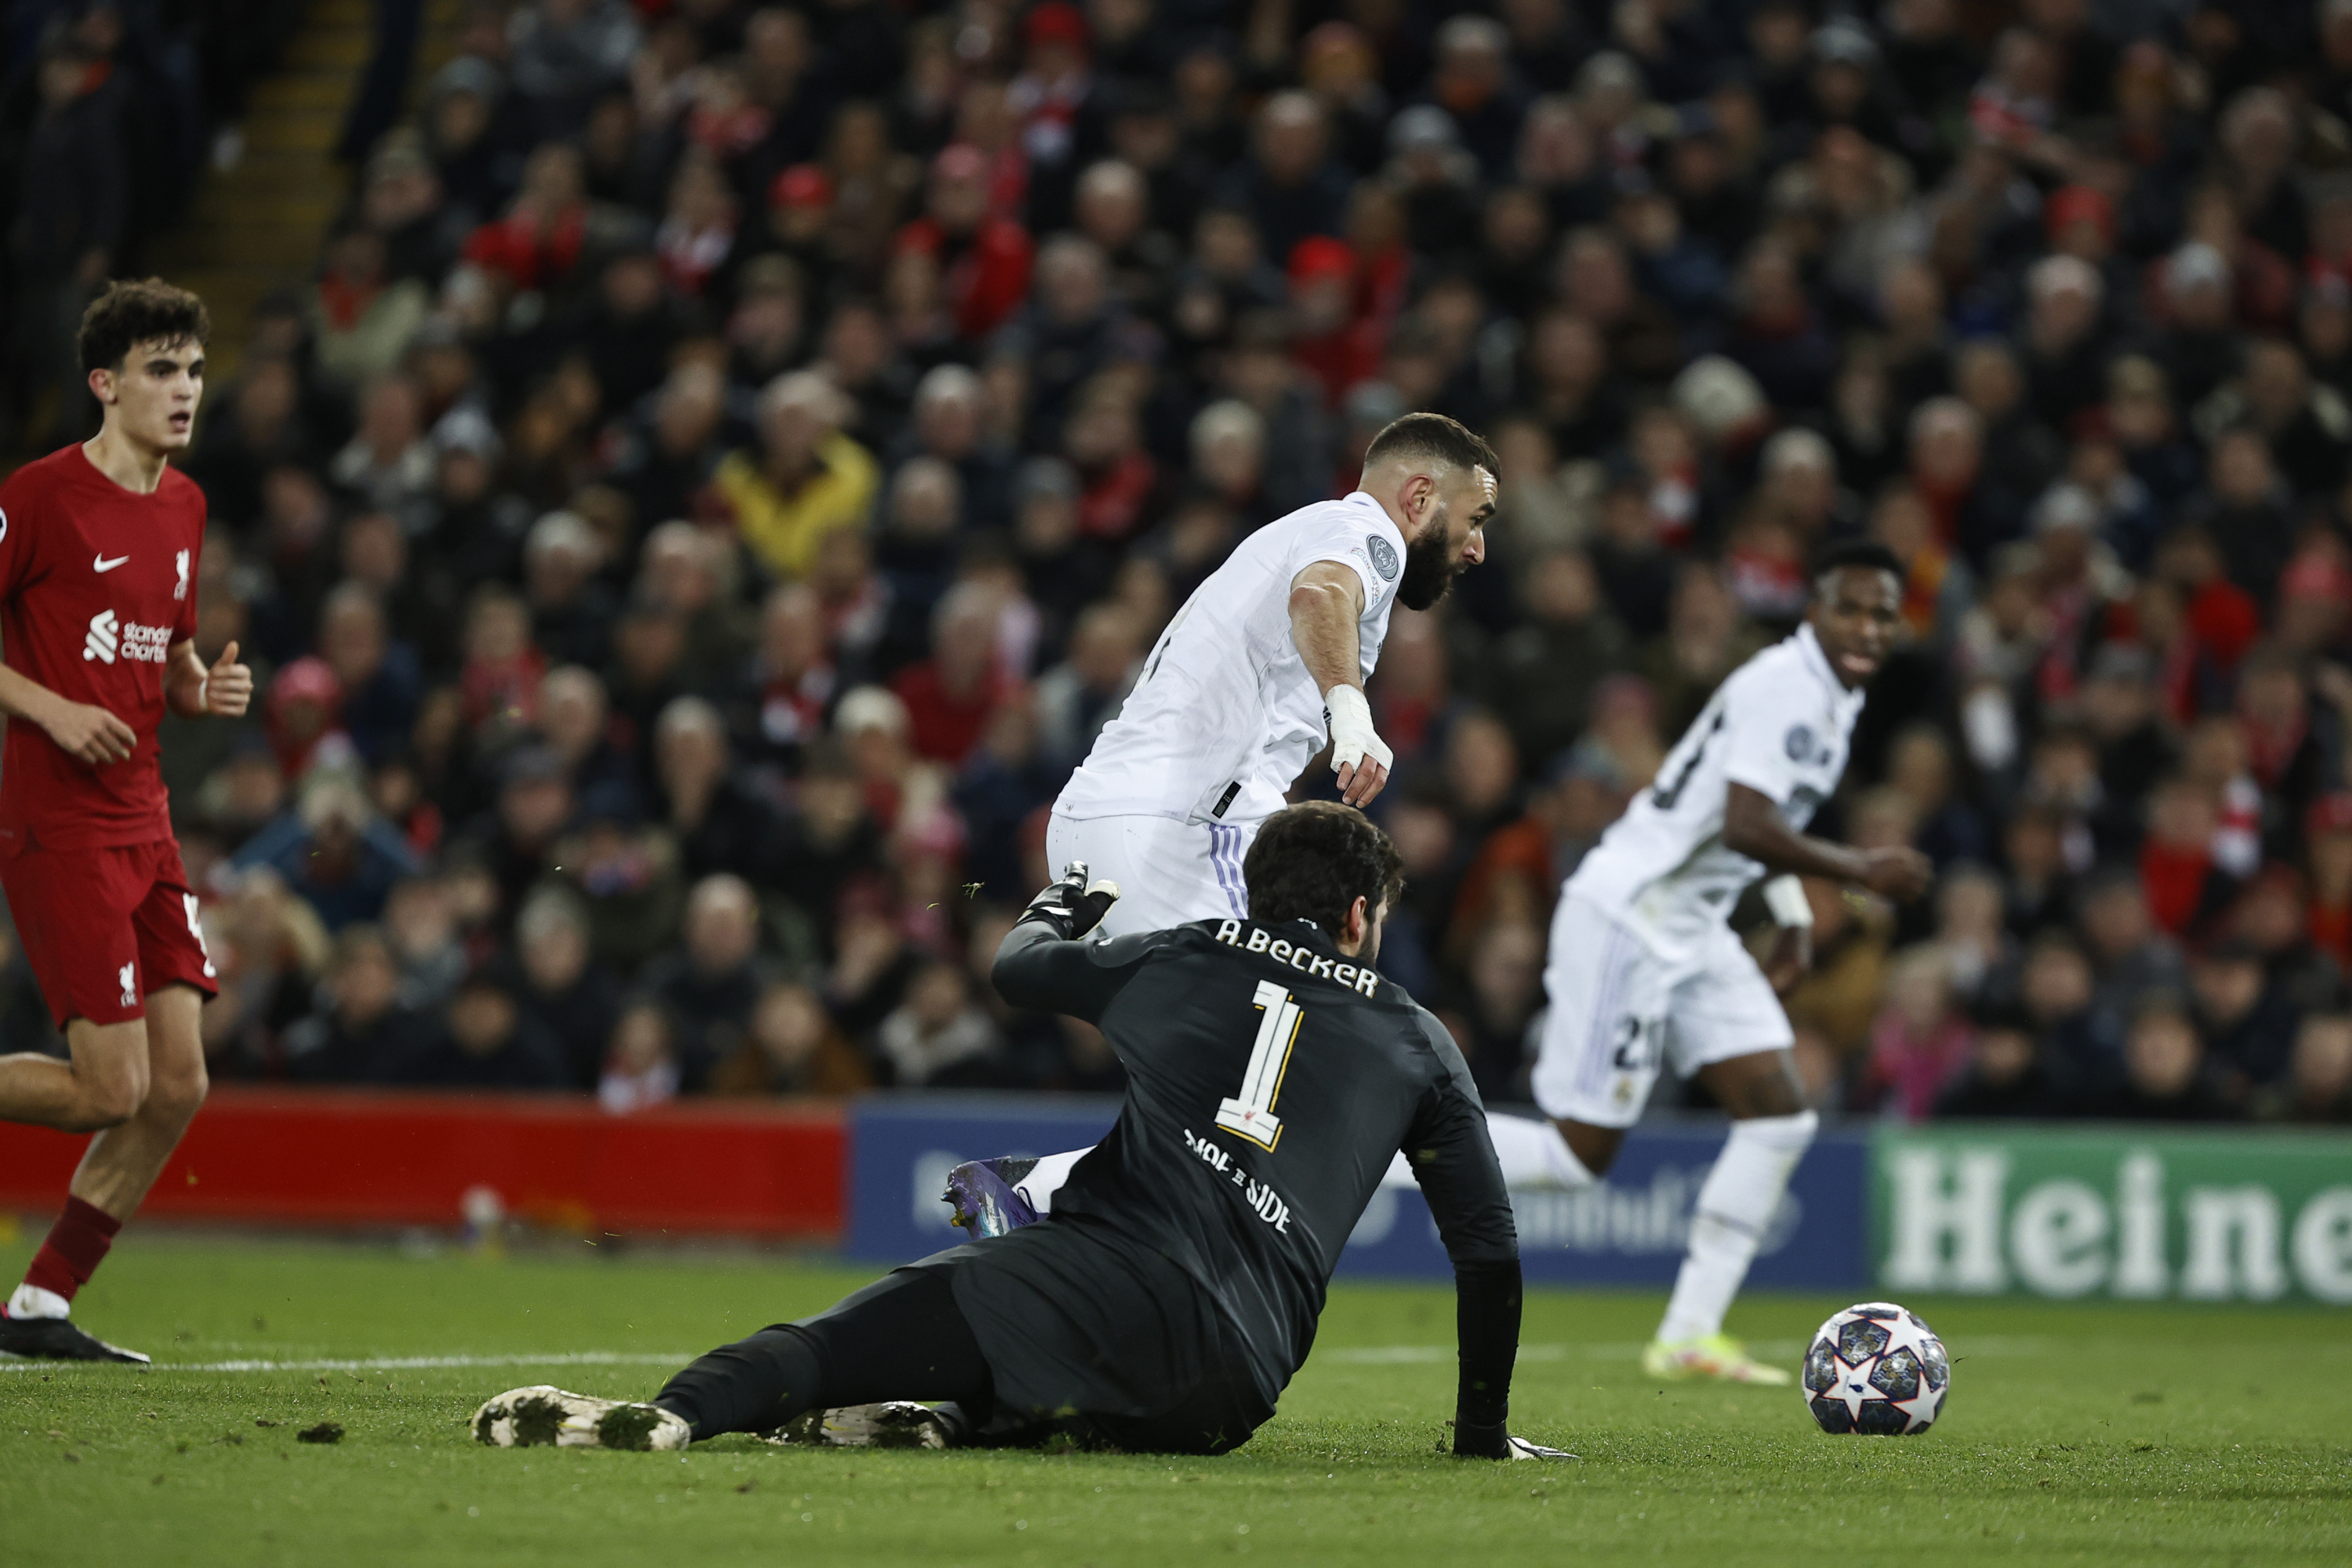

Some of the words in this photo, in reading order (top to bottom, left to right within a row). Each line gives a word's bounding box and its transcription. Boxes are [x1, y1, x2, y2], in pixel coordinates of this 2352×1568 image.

[1351, 548, 1380, 604] FOUNDATION
[1214, 979, 1305, 1153] 1
[1246, 1178, 1291, 1234] SIDE
[1885, 1146, 2352, 1301] Heine
